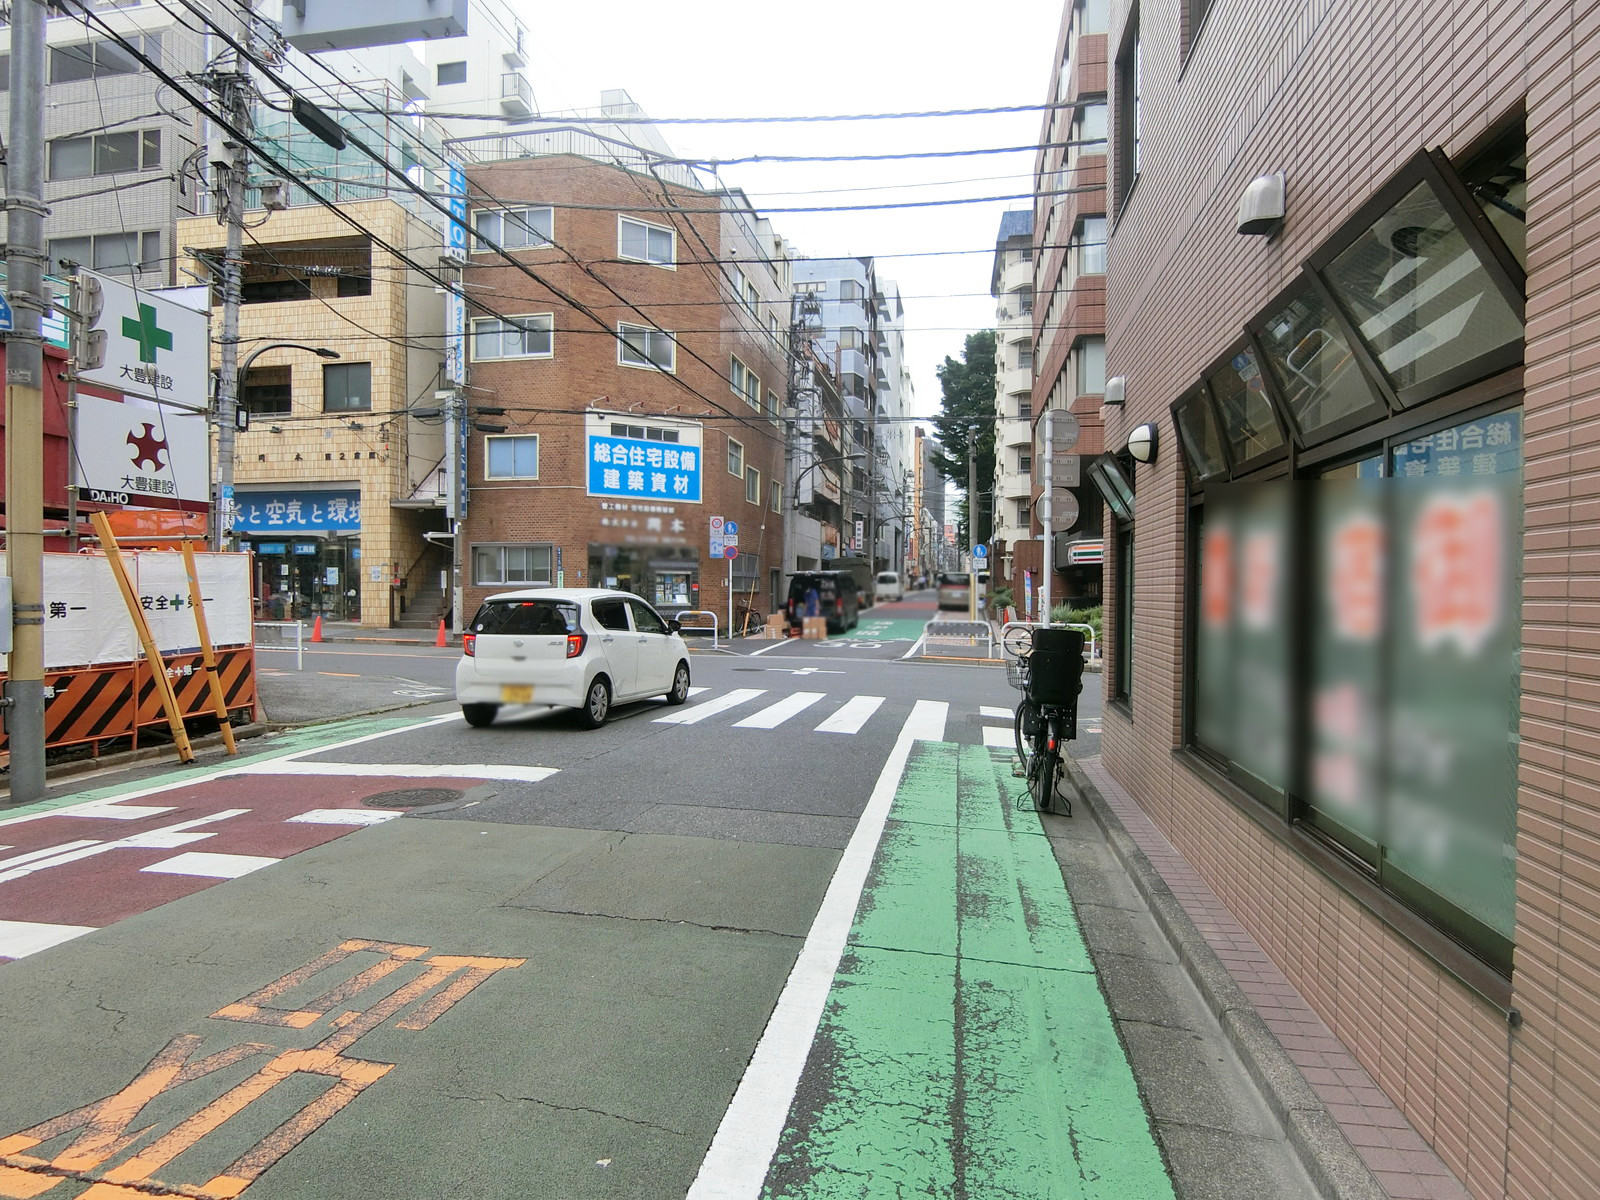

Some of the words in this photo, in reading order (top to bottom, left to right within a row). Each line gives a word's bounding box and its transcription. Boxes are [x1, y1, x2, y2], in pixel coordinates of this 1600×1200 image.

[120, 364, 174, 391] 大豊建設
[594, 442, 696, 472] 総合住宅設備
[121, 474, 175, 495] 大豊建設
[603, 468, 689, 495] 建築資材
[49, 601, 87, 619] 第一
[140, 595, 168, 611] 安全
